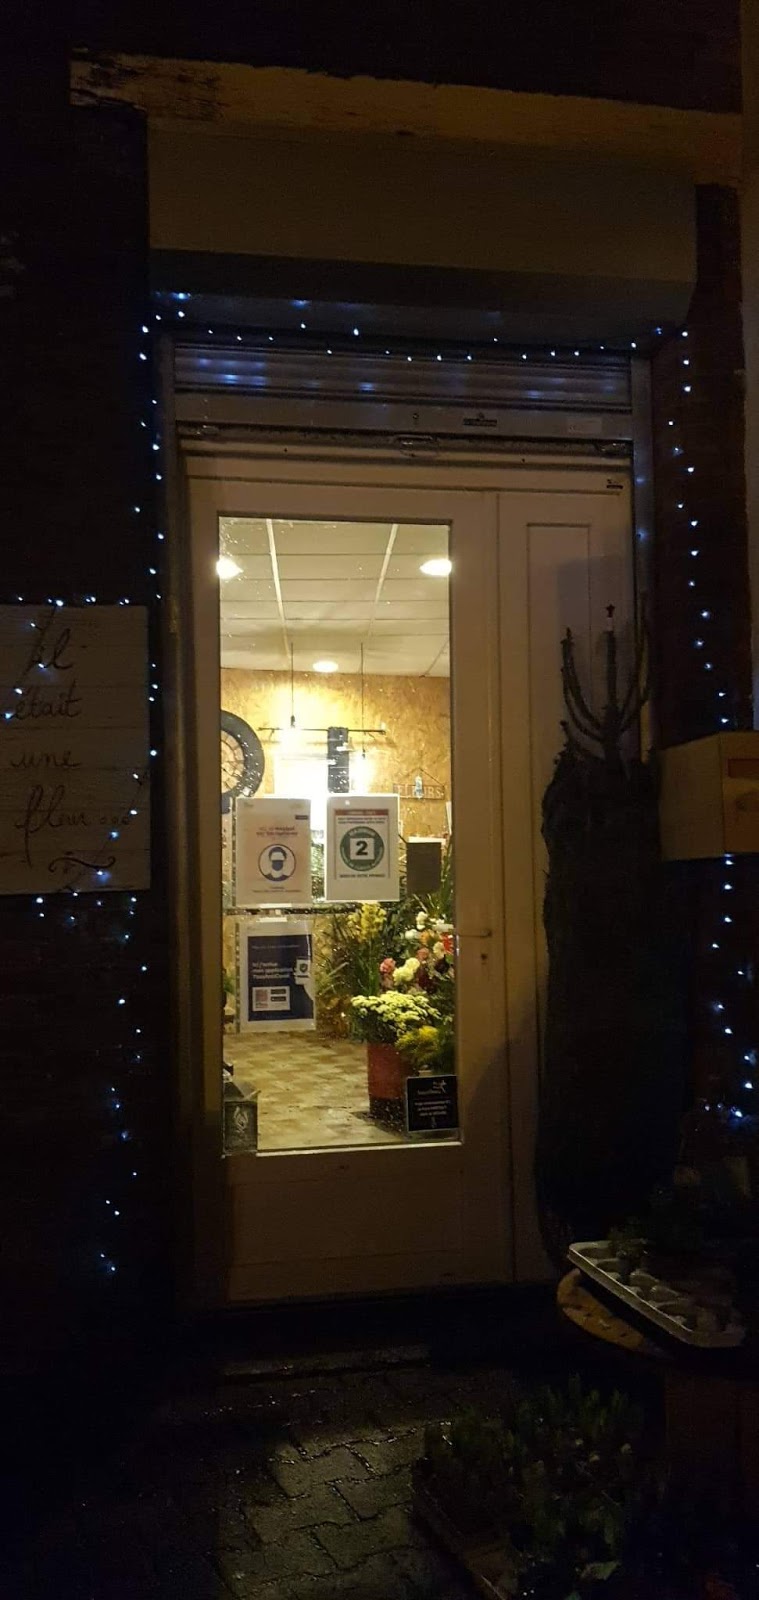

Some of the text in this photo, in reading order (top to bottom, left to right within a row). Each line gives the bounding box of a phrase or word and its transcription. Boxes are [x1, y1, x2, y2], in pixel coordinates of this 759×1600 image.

[14, 679, 83, 720] était
[10, 750, 82, 769] une
[397, 784, 443, 799] FLRS
[355, 840, 368, 856] 2
